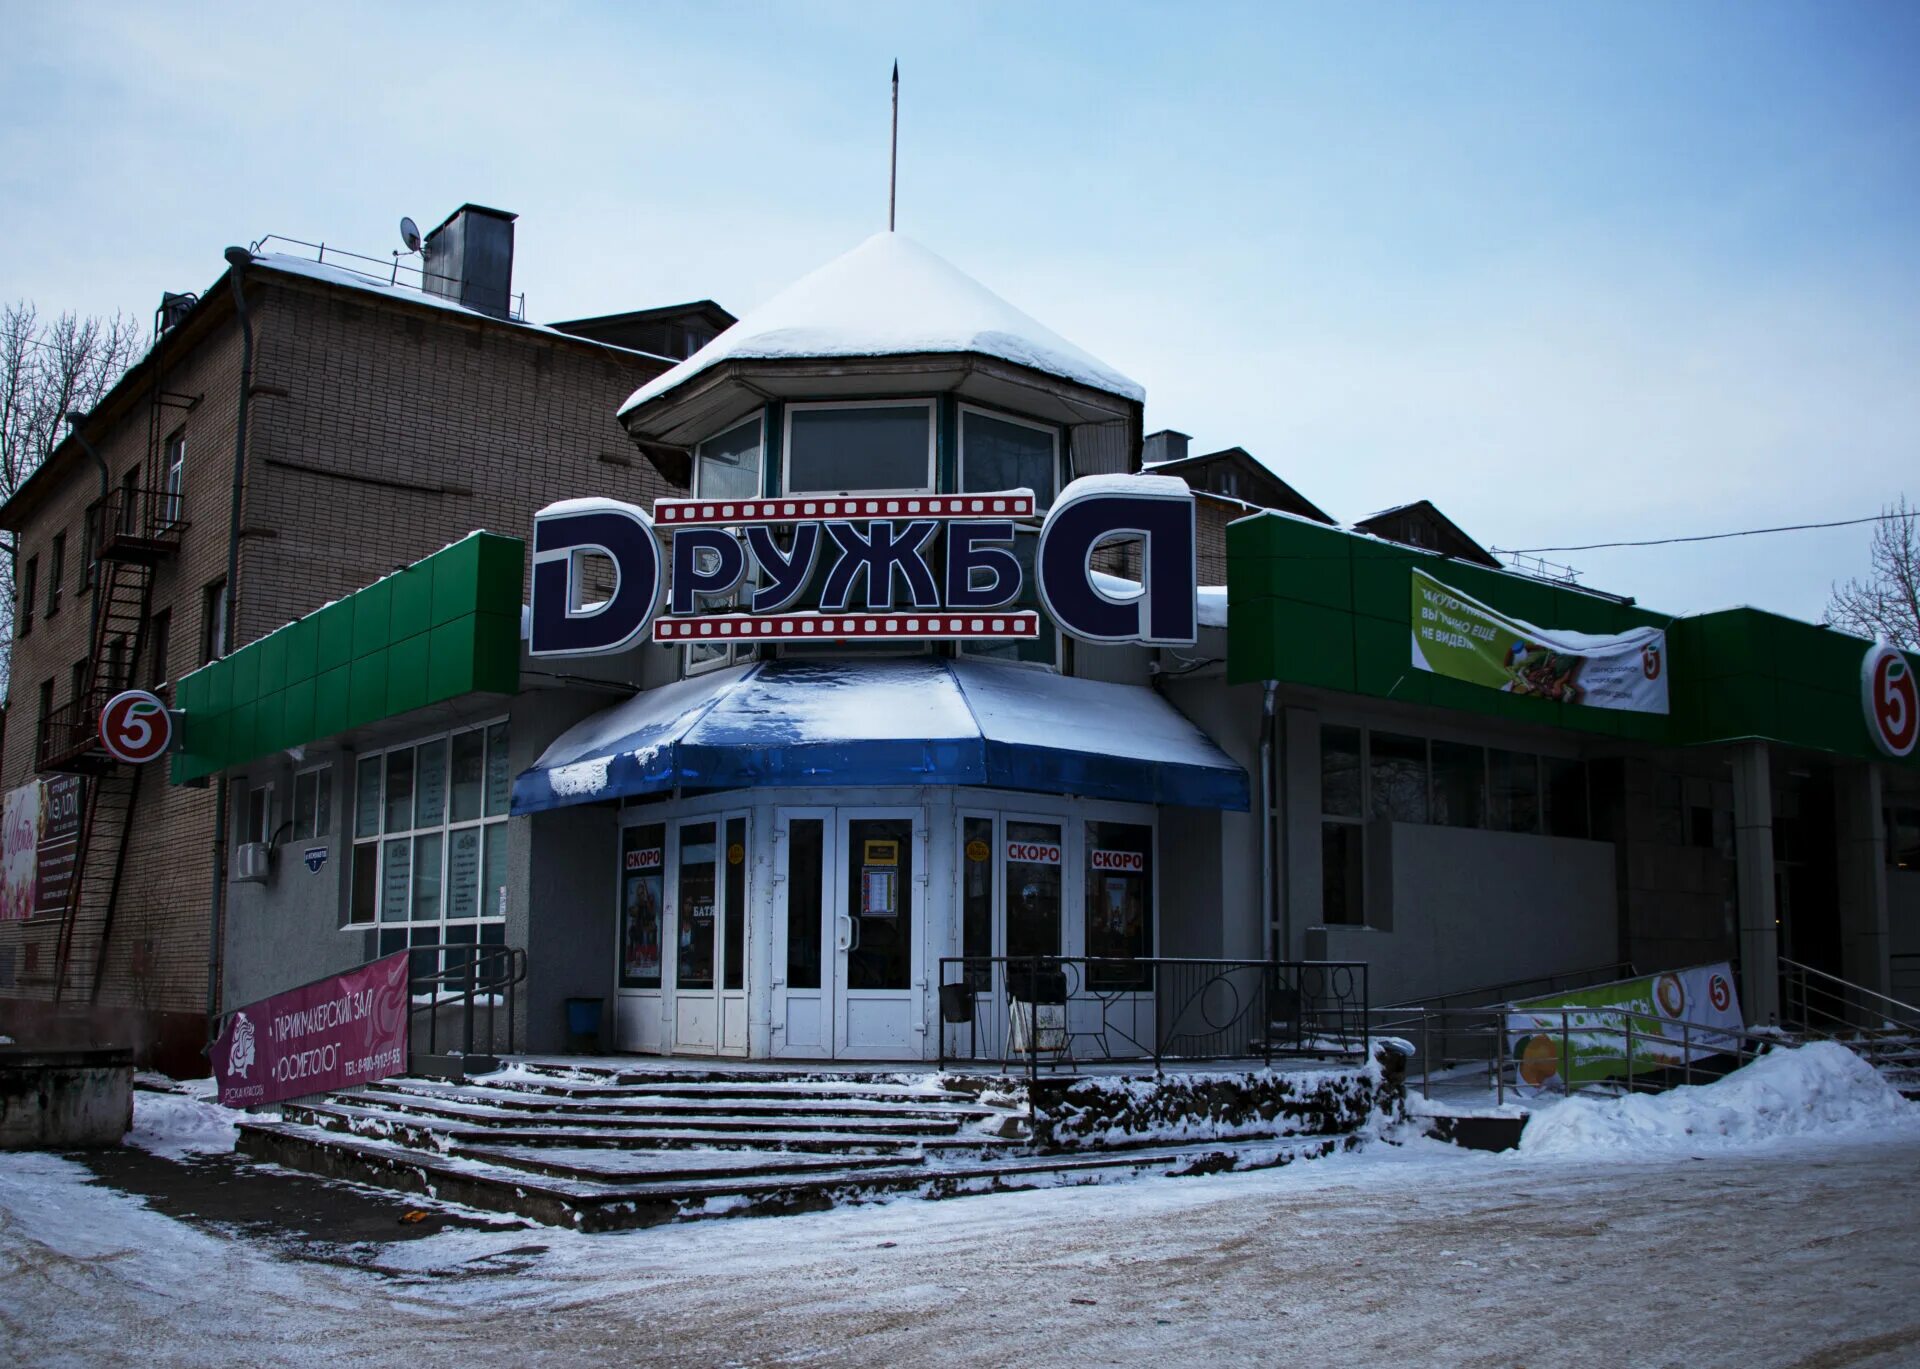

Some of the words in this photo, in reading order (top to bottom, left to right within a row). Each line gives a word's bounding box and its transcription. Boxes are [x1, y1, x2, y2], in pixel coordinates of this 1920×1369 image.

[1421, 607, 1438, 622] ВЫ
[1421, 626, 1434, 640] НЕ
[119, 700, 162, 750] 5
[627, 850, 660, 869] СКОРО
[1008, 843, 1060, 862] СКОРО
[1093, 852, 1142, 869] СКОРО
[693, 905, 715, 917] БАТЯ
[353, 988, 373, 1020] ЗАЛ
